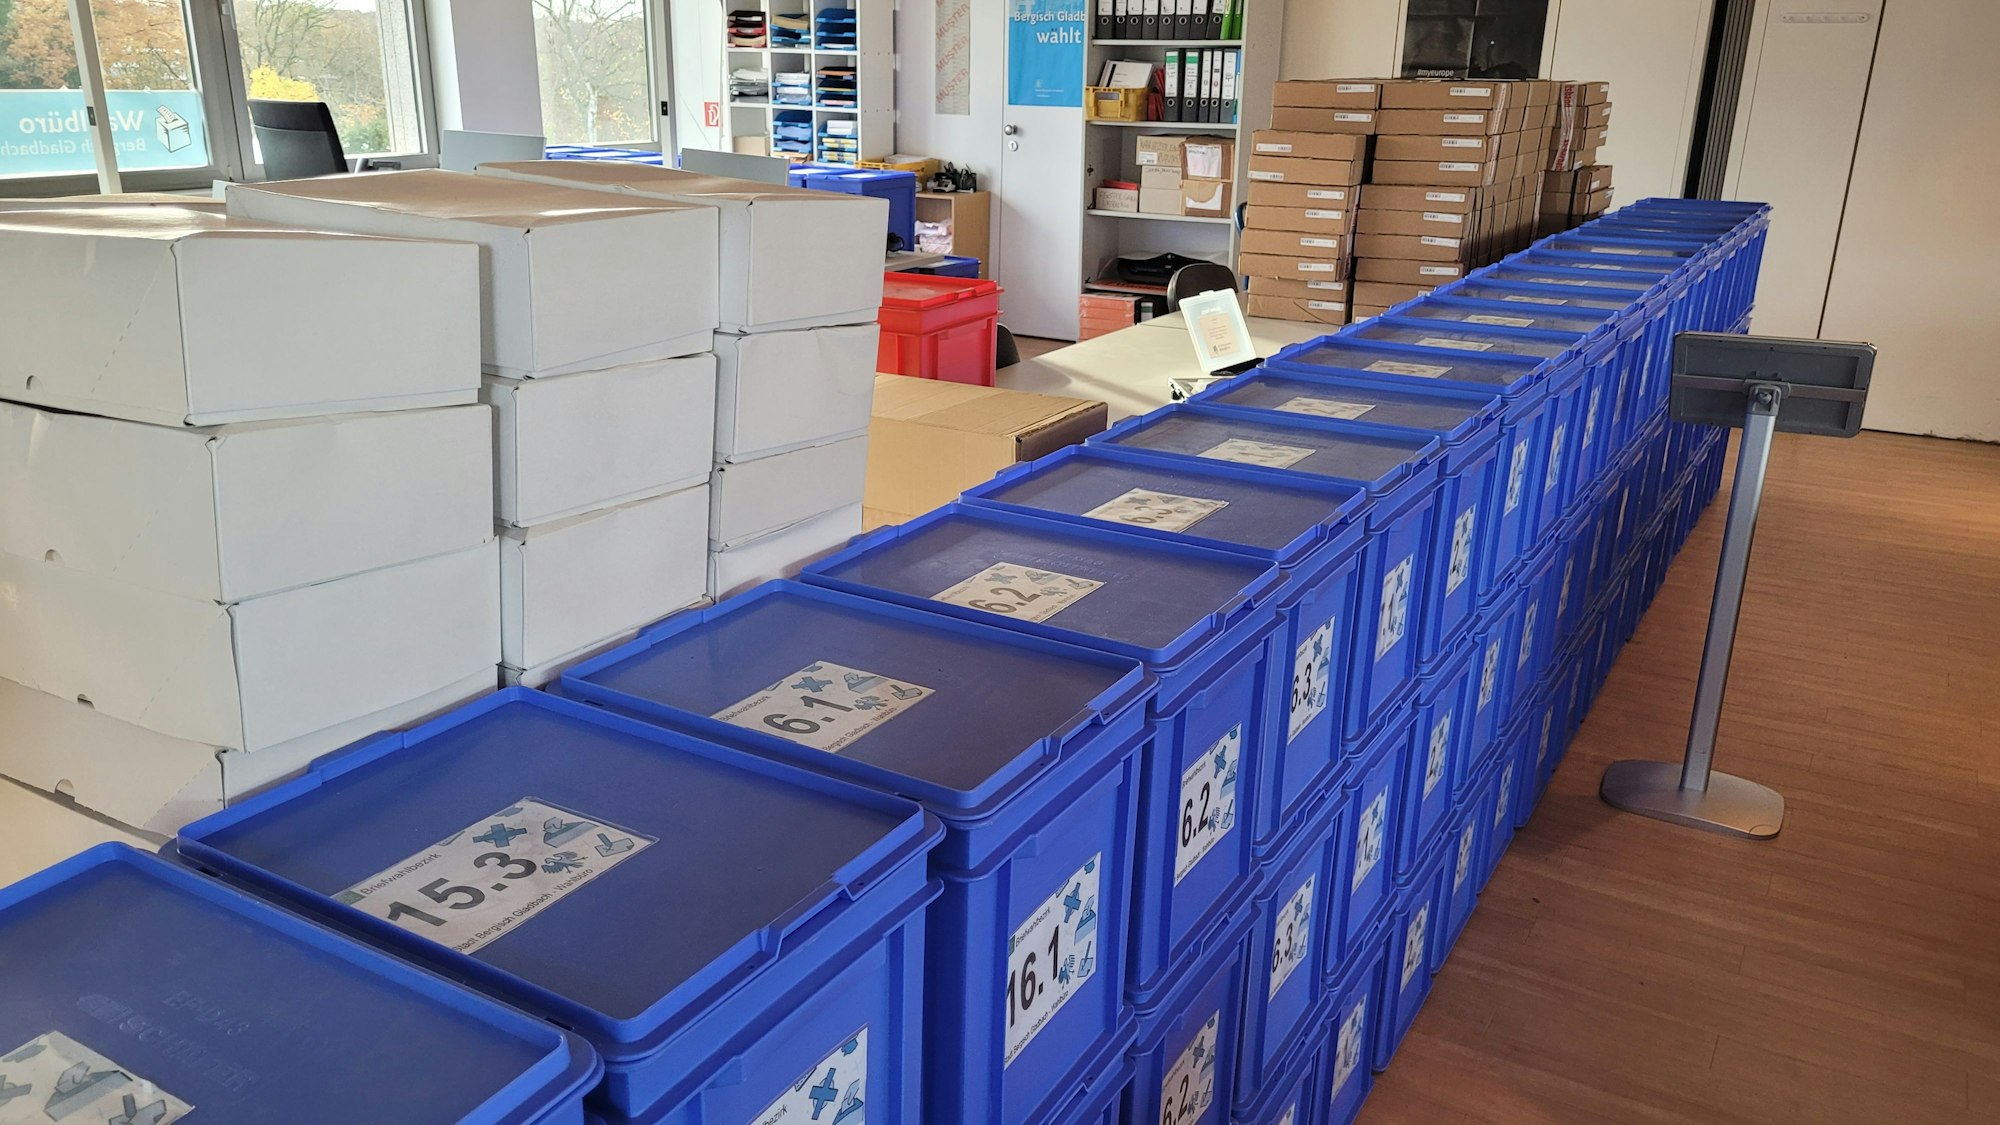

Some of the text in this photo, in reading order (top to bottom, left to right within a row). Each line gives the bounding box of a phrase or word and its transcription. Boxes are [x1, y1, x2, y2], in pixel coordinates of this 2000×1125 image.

[936, 3, 969, 40] MUSTER
[1014, 11, 1054, 24] Bergisch
[1036, 26, 1081, 44] wählt
[936, 35, 969, 72] MUSTER
[1417, 69, 1454, 77] #myeurope
[936, 67, 969, 104] MUSTER
[1119, 505, 1176, 524] 6.3
[968, 587, 1042, 613] 6.2
[1290, 662, 1312, 713] 6.3
[763, 695, 854, 734] 6.1
[1181, 781, 1211, 848] 6.2
[360, 853, 442, 895] Briefwahlbezirk
[386, 851, 538, 928] 15.3
[476, 915, 514, 940] Bergisch
[512, 892, 552, 917] Gladbach
[554, 868, 593, 891] Wahlbüro
[1271, 922, 1293, 973] 6.3
[1006, 924, 1060, 1029] 16.1
[1162, 1074, 1189, 1125] 6.2
